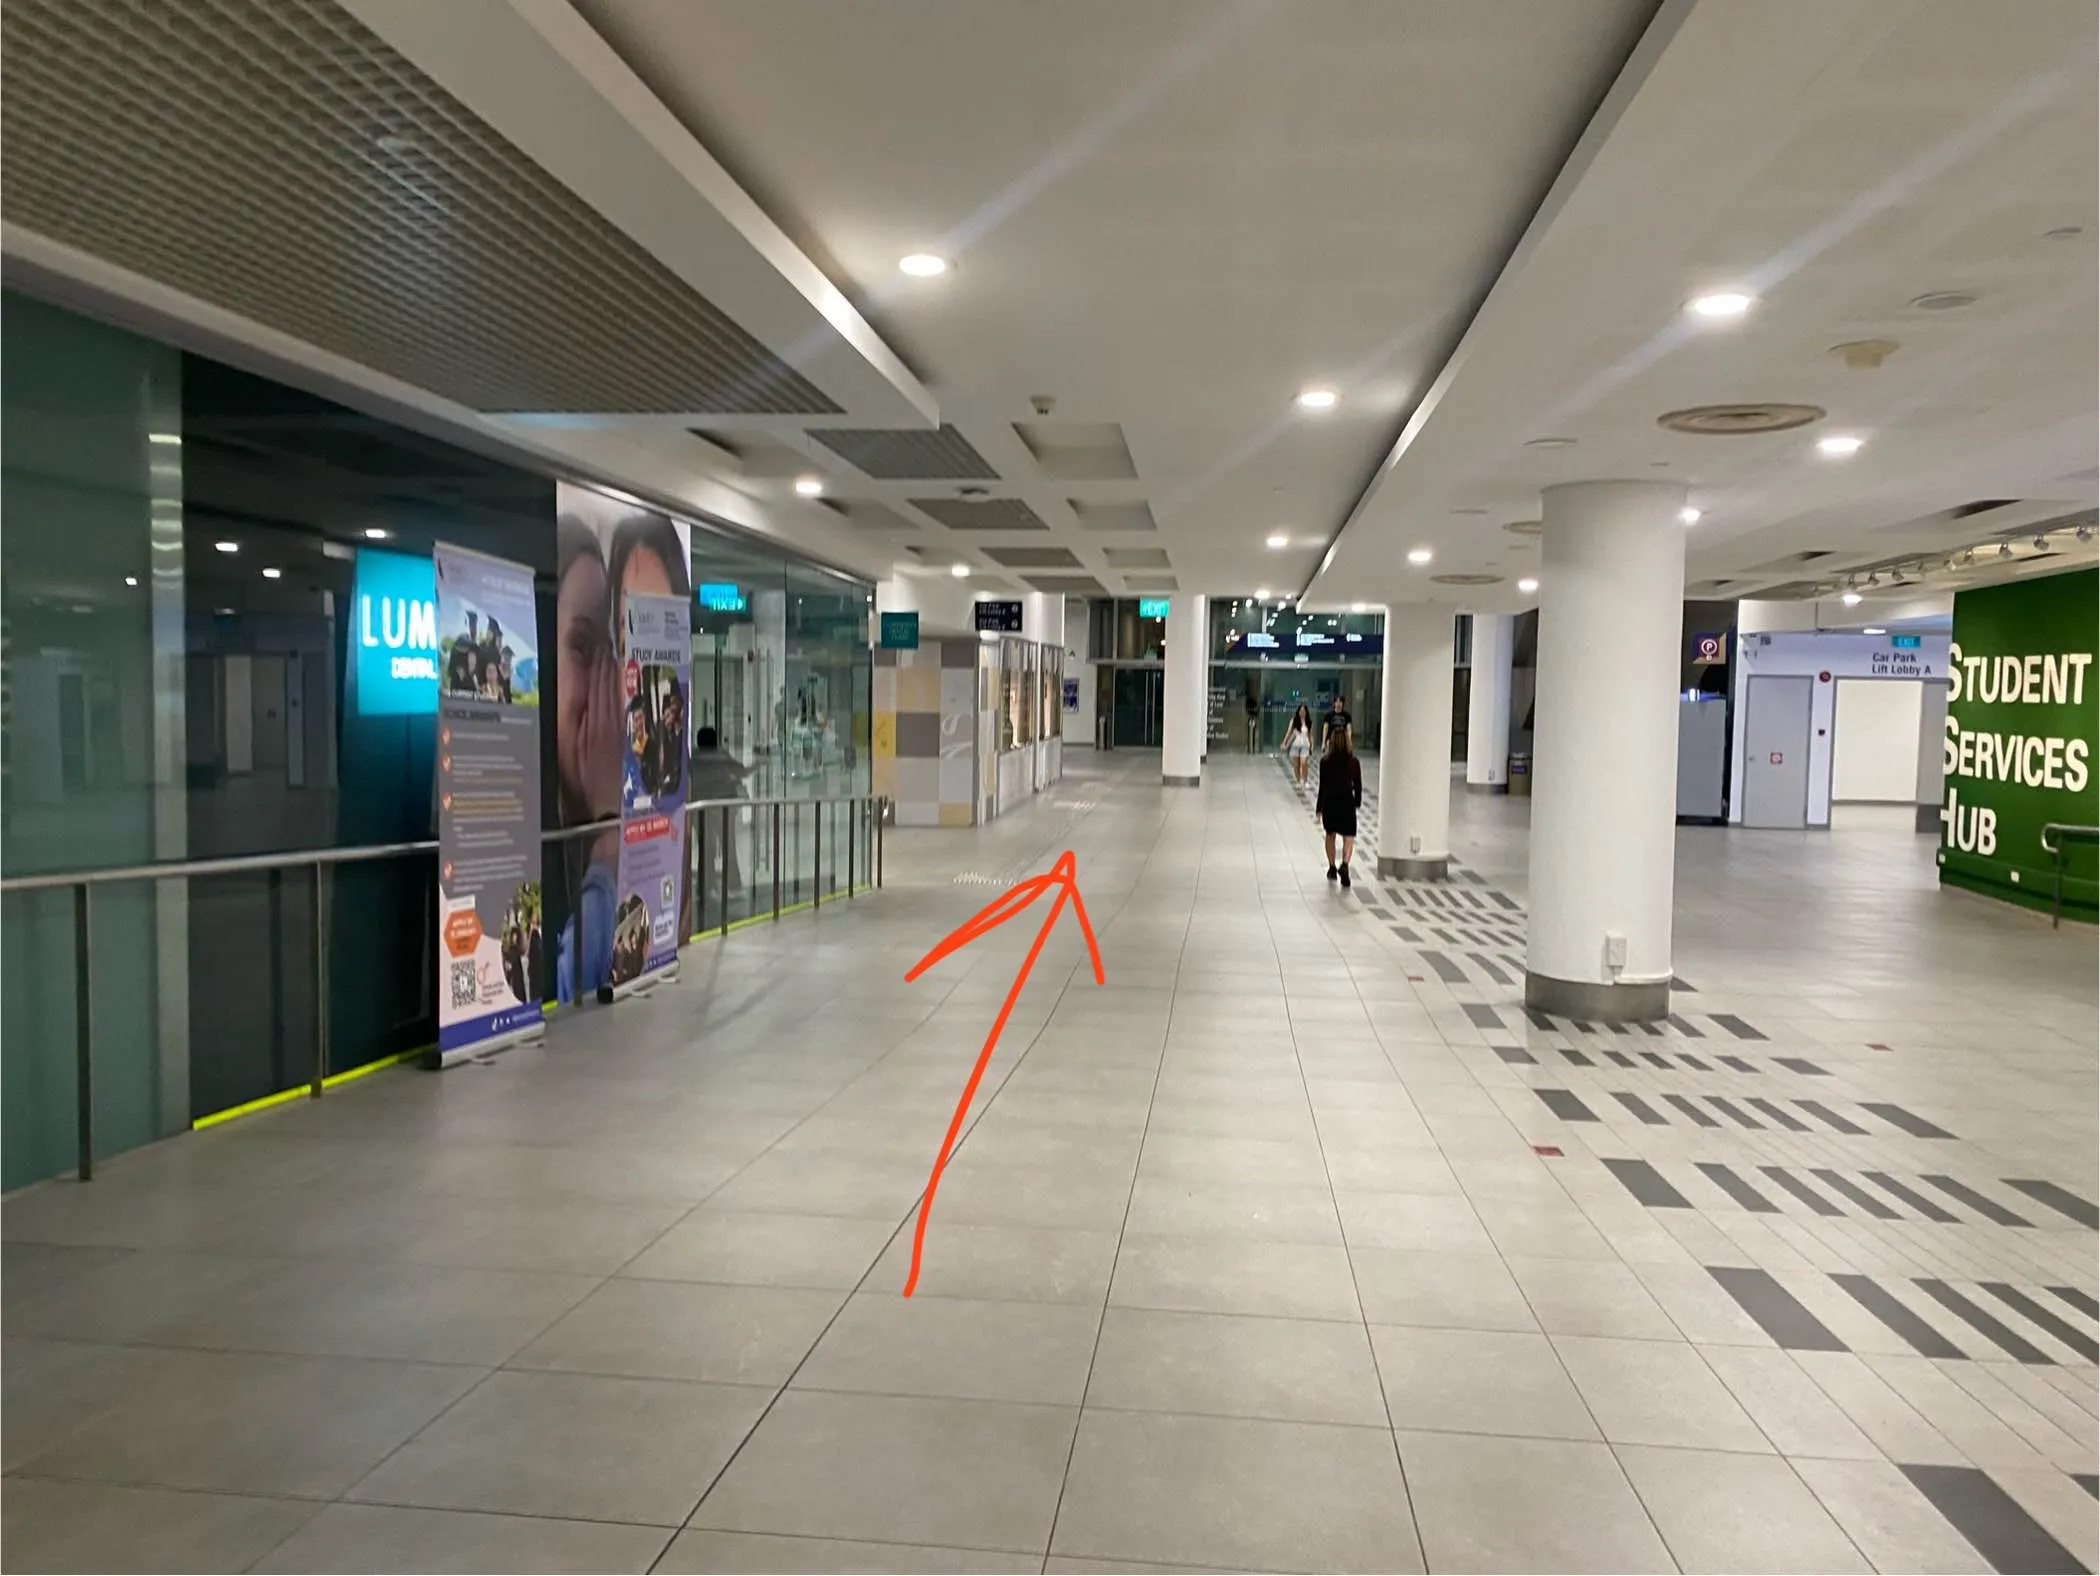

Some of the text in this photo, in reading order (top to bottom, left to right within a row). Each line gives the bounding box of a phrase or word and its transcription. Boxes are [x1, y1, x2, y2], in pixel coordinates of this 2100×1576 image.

[1146, 601, 1168, 616] EXIT
[1872, 653, 1916, 663] Car Park
[1872, 664, 1932, 676] Lift Lobby A
[1946, 643, 2092, 704] STUDENT
[1943, 716, 2089, 792] SERVICES
